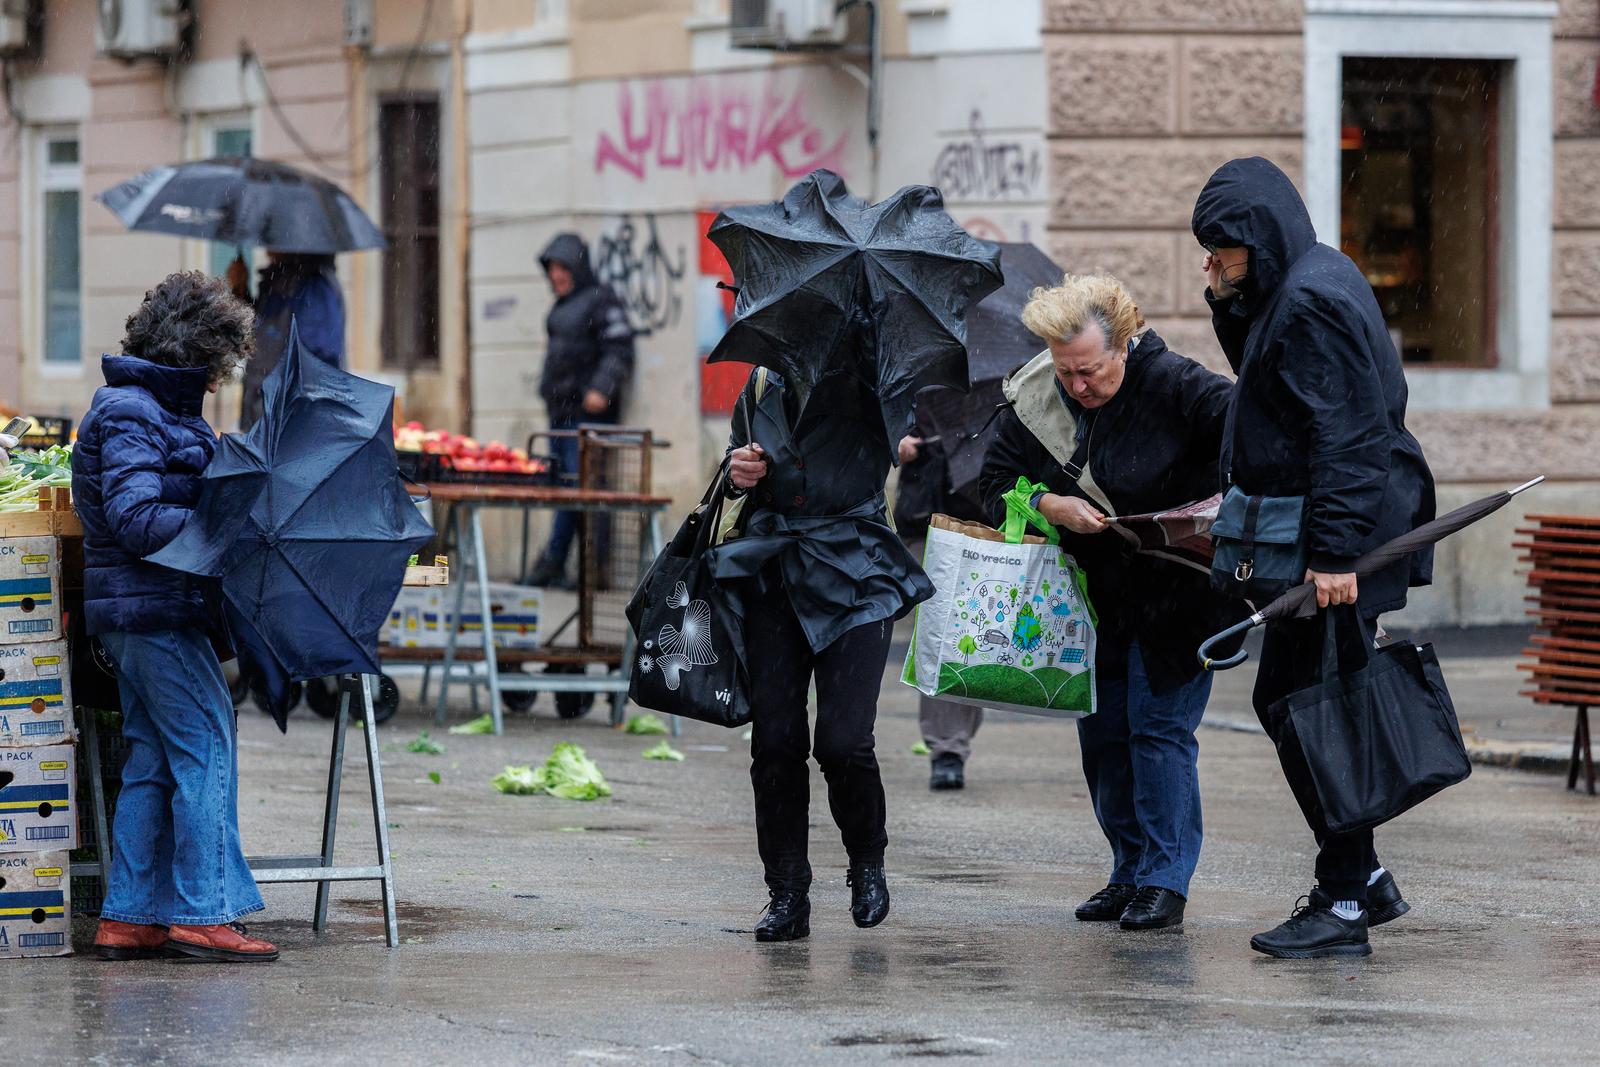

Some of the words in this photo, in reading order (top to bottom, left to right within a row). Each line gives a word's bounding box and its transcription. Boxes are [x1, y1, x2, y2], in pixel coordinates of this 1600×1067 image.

[0, 546, 15, 555] CK
[962, 549, 980, 560] EKO
[0, 648, 26, 658] PACK
[7, 751, 33, 760] PACK
[0, 858, 27, 867] PACK
